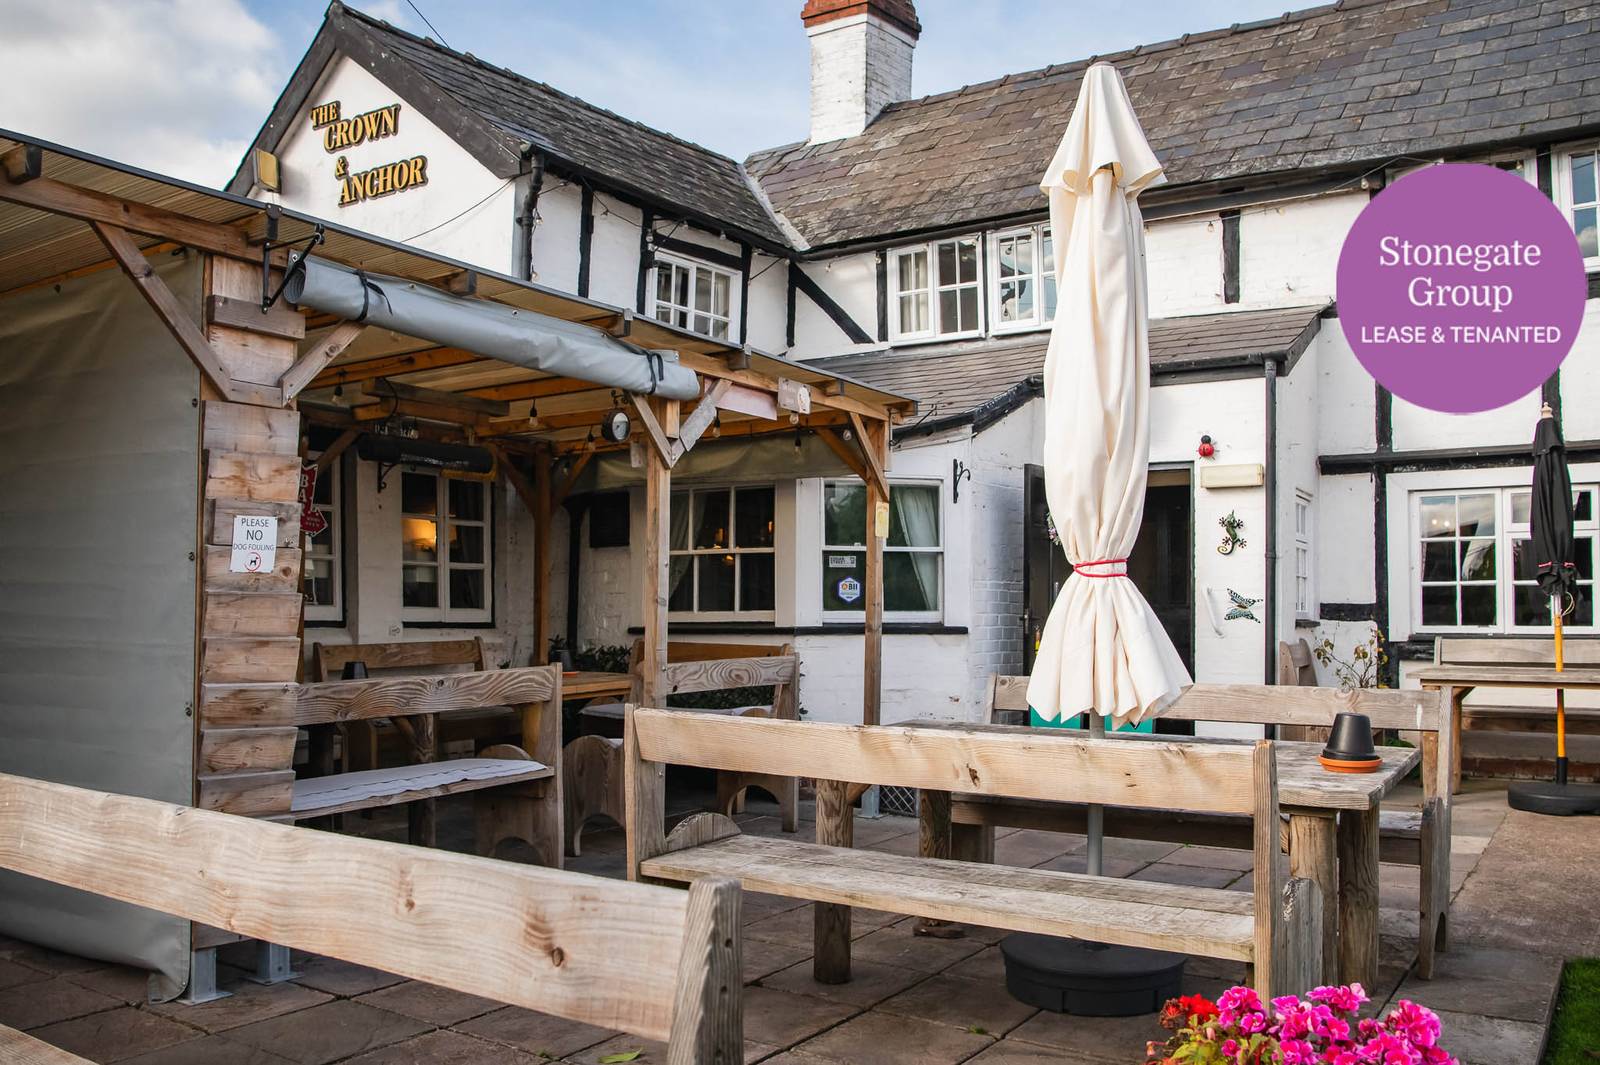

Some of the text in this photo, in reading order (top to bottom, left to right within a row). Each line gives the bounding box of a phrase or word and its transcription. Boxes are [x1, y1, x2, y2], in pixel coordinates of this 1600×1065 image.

[311, 101, 340, 129] THE
[324, 103, 400, 152] CROWN
[335, 156, 348, 178] &
[338, 156, 427, 207] ANCHOR
[241, 517, 269, 528] PLEASE
[246, 529, 264, 541] NO
[233, 543, 275, 551] DOG FOULING
